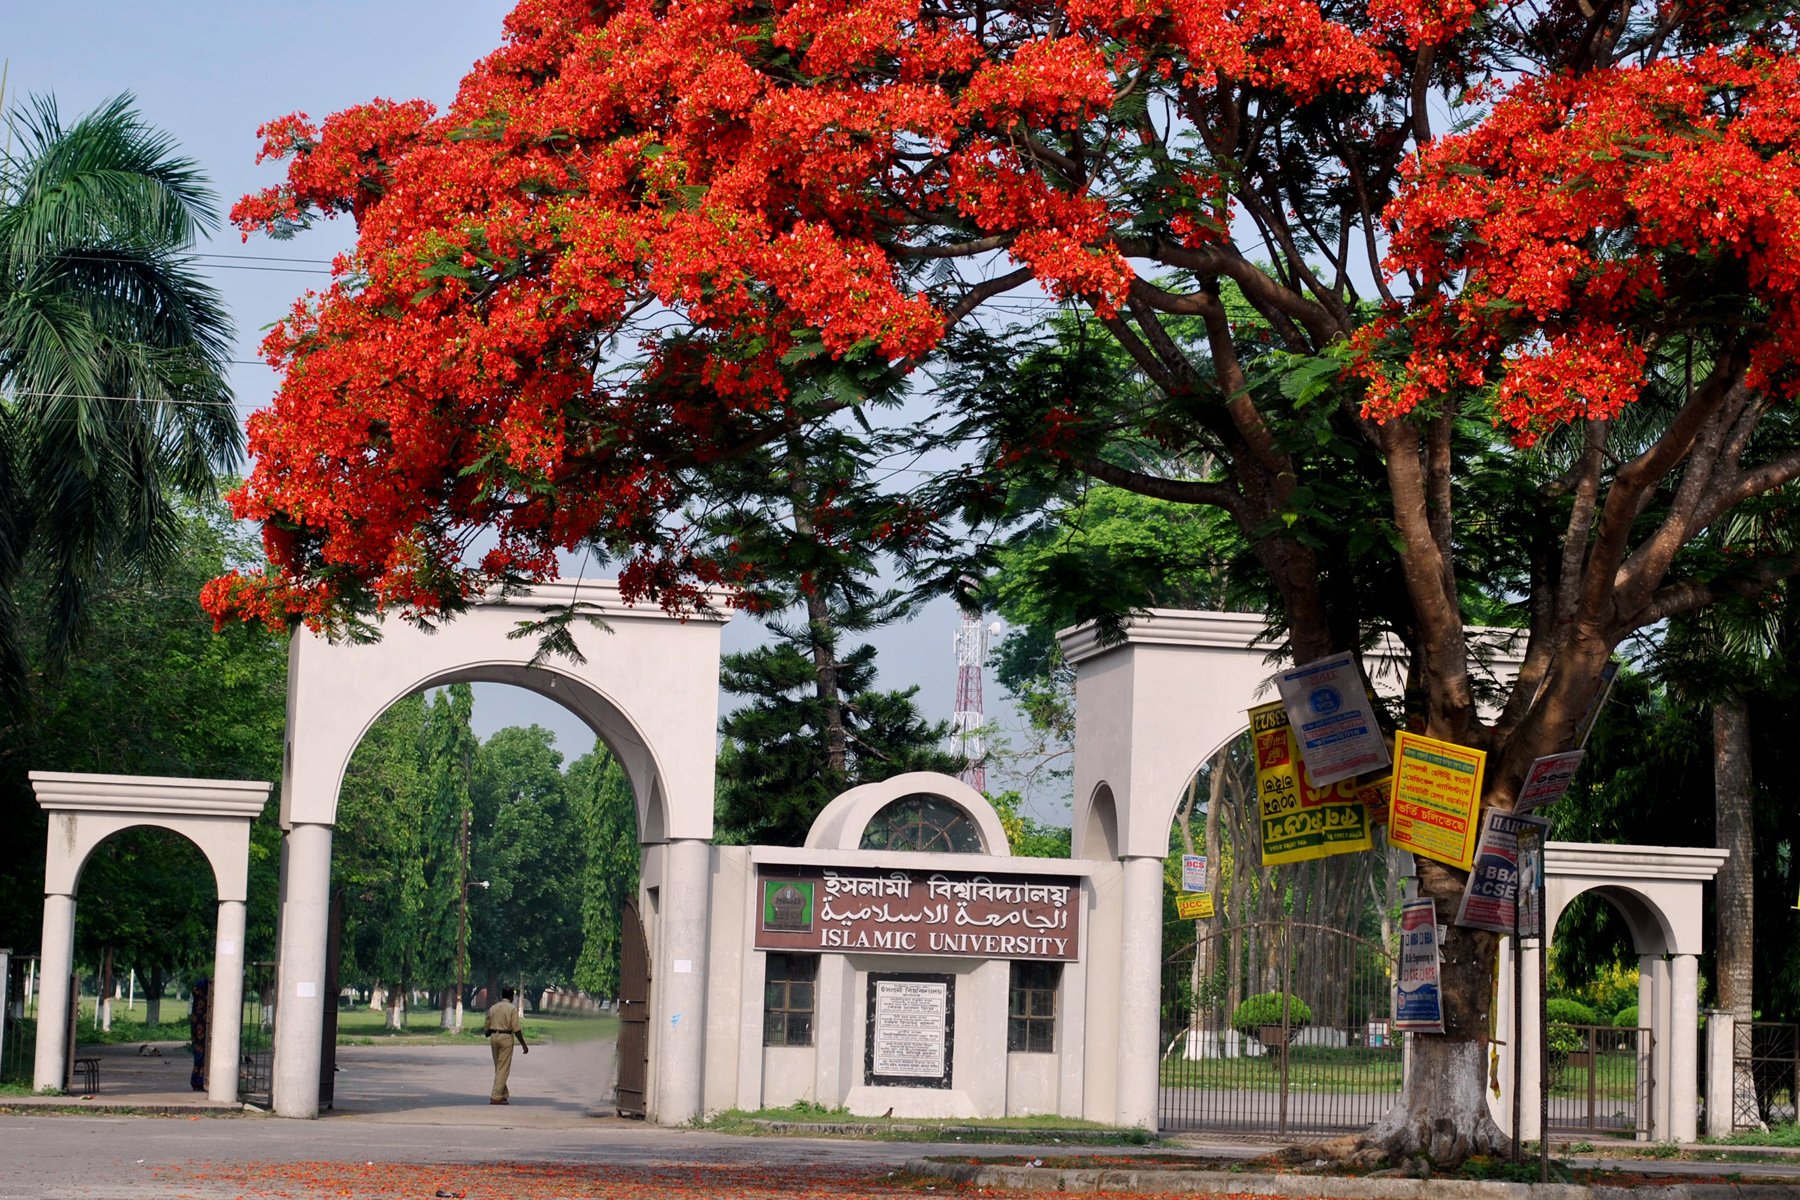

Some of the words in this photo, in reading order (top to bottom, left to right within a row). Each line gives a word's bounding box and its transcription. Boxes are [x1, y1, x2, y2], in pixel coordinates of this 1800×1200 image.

[1263, 775, 1294, 795] ভাইভা
[1263, 793, 1297, 815] ৩০তম
[1397, 802, 1419, 816] ভর্তি
[1421, 809, 1465, 831] চলিতেছে
[1186, 860, 1204, 869] BCS
[1485, 866, 1517, 884] BBA
[823, 870, 912, 899] ইসলামী
[927, 873, 1070, 908] বিশ্ববিদ্যালয়
[1481, 881, 1515, 899] CSE
[1182, 901, 1203, 909] UCC
[955, 901, 1069, 933] الجامعة
[820, 928, 916, 950] ISLAMIC
[929, 931, 1069, 956] UNIVERSITY
[1410, 968, 1419, 981] CSE
